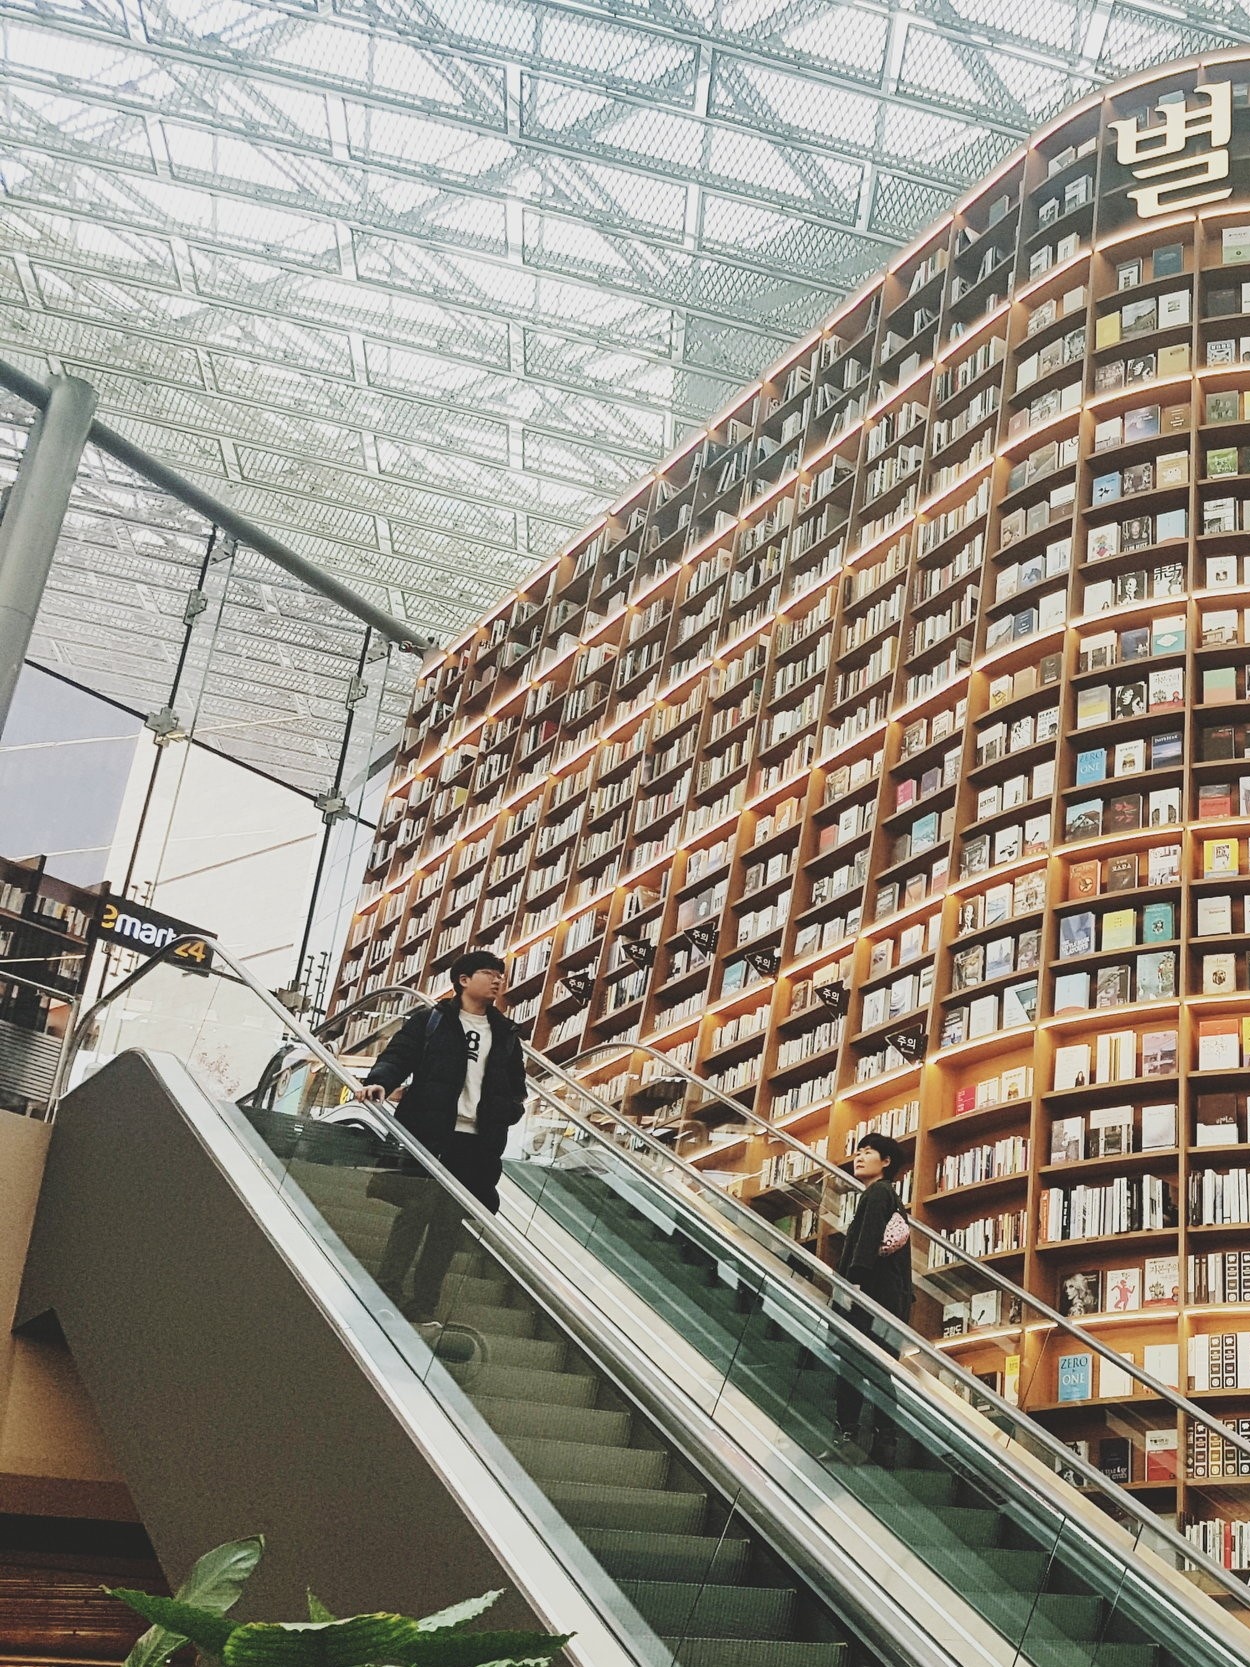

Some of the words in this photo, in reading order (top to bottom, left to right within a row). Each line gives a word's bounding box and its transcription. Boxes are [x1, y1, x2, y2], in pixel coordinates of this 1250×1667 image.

[692, 929, 709, 942] 주의
[630, 944, 646, 957] 주의
[755, 955, 771, 968] 주의
[569, 979, 585, 991] 주의
[823, 988, 840, 1002] 주의
[897, 1035, 917, 1050] 주의
[1061, 1357, 1088, 1370] ZERO
[1062, 1374, 1085, 1385] ONE
